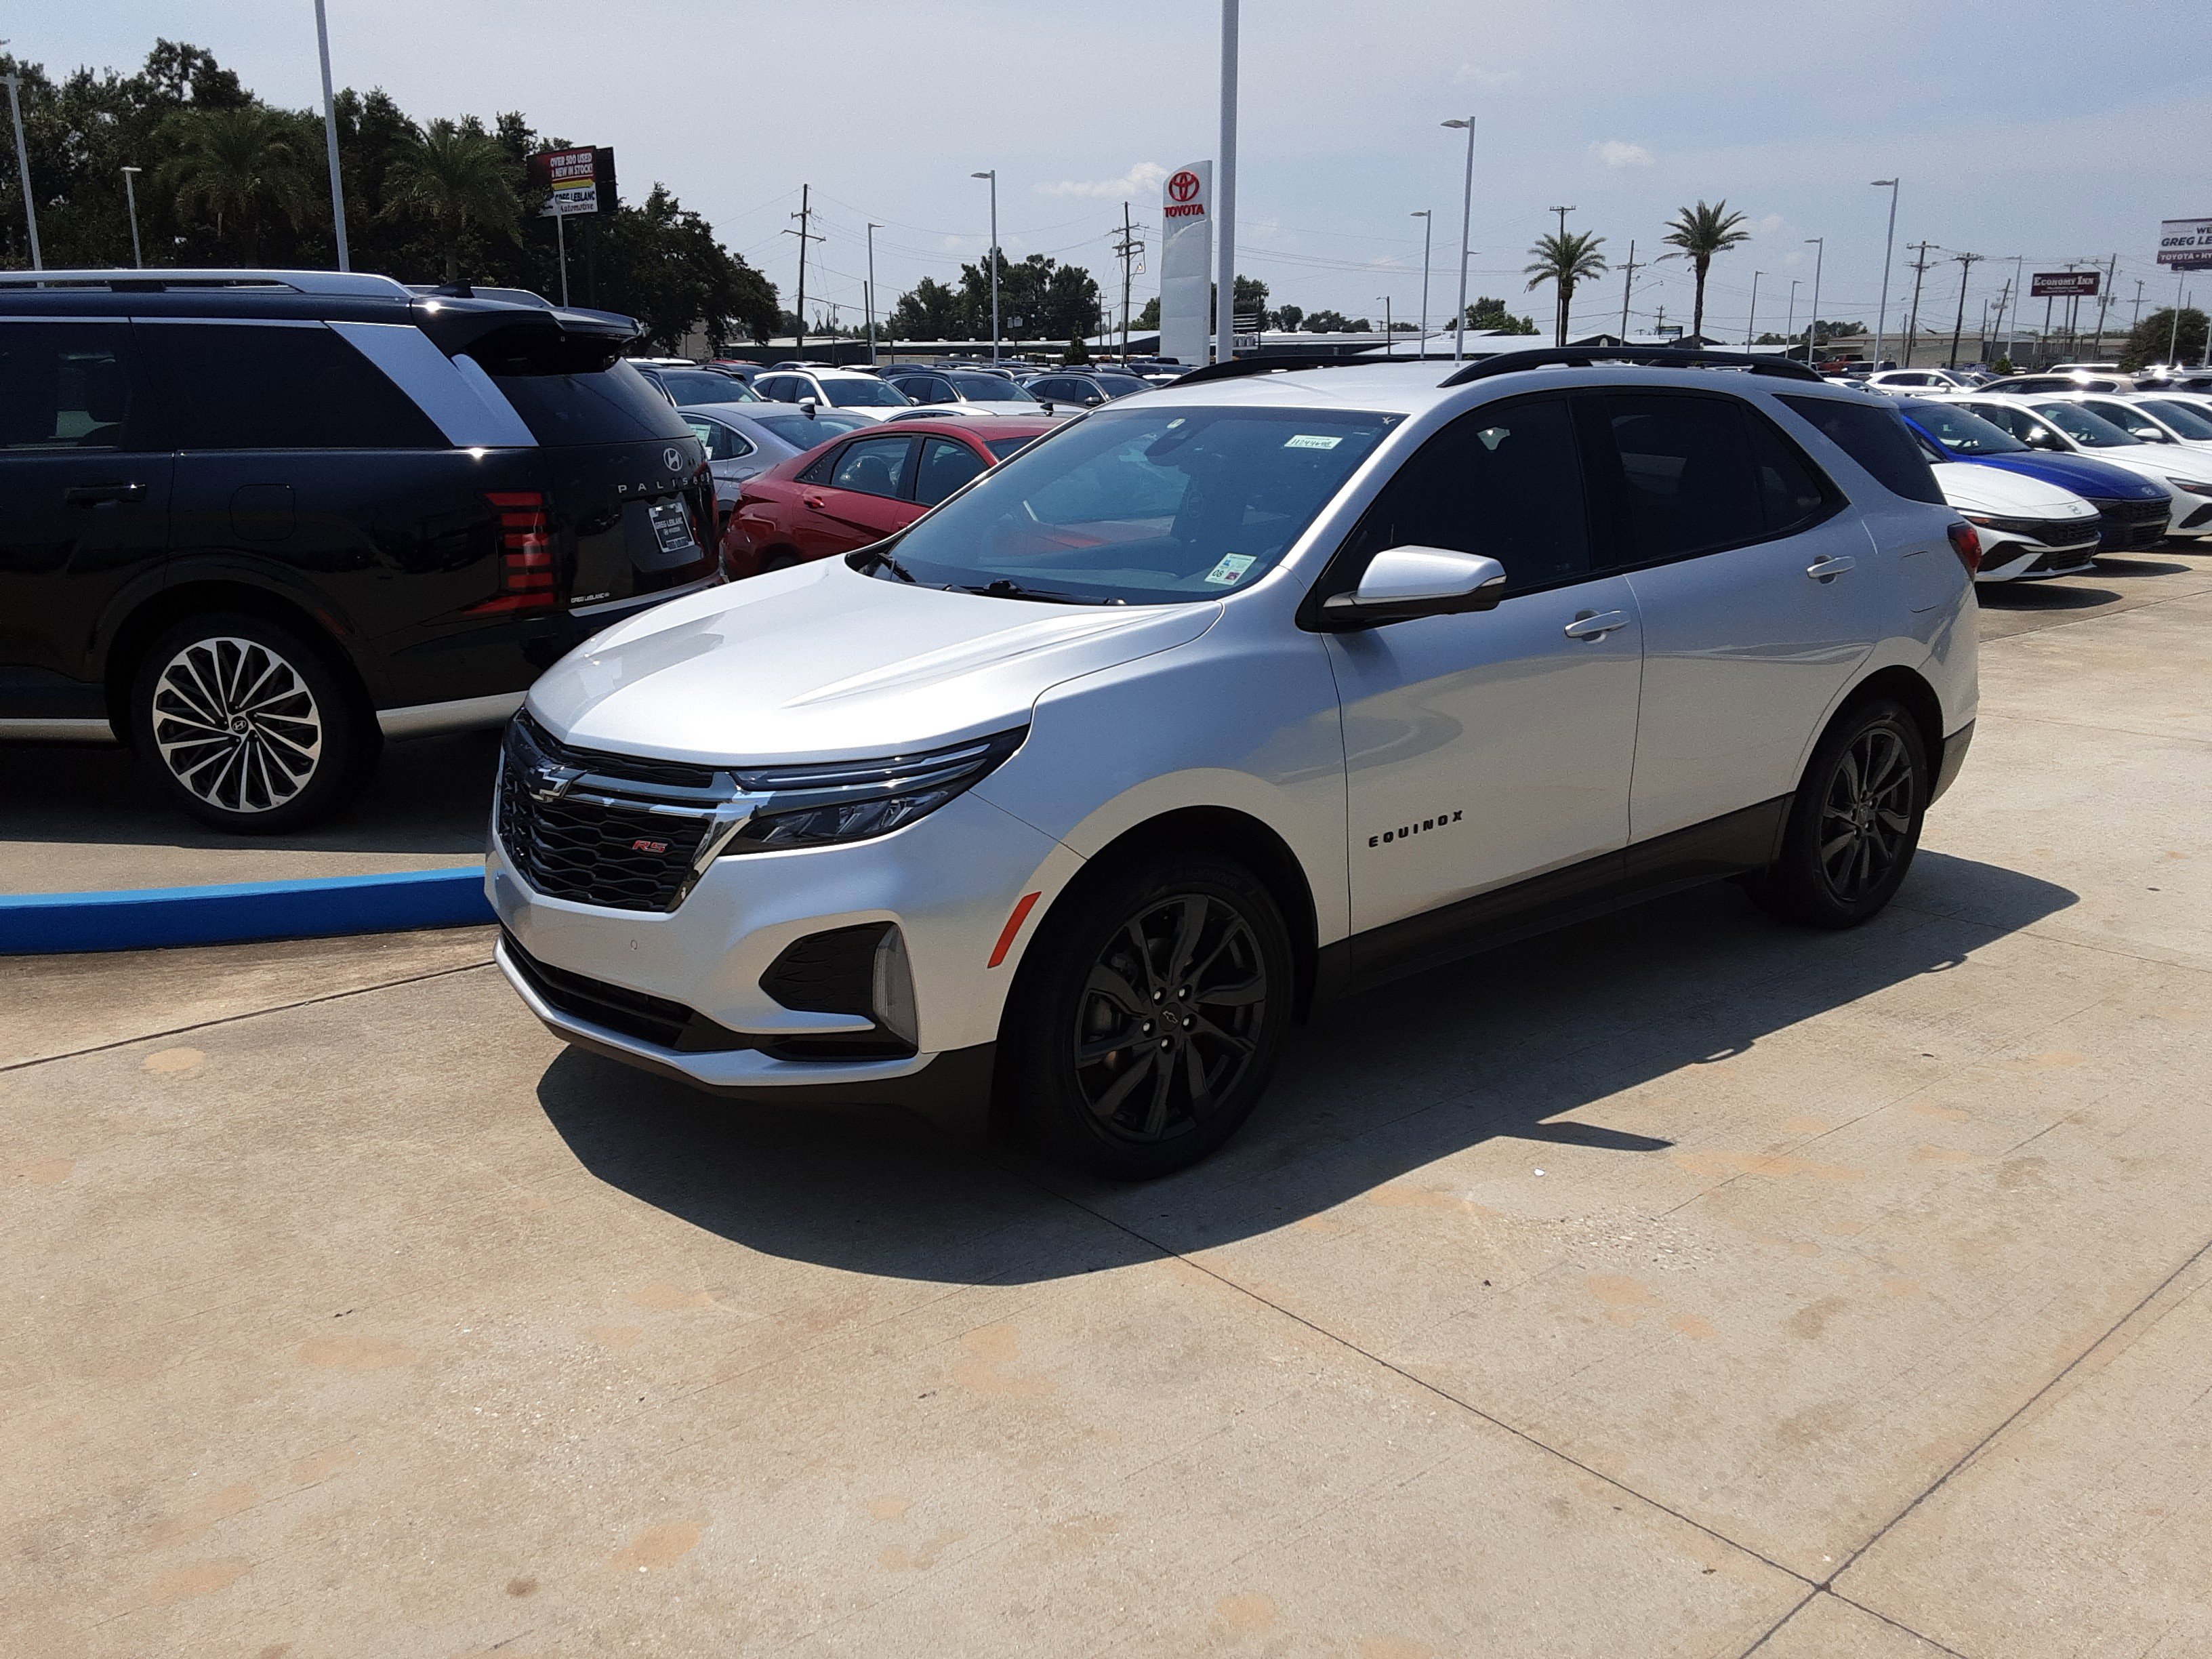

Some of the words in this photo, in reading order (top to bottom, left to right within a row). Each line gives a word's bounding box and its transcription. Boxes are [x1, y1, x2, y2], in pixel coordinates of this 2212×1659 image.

[550, 156, 565, 167] OVER
[566, 154, 576, 165] 500
[577, 152, 592, 163] USED
[555, 167, 567, 178] NEW
[568, 165, 574, 176] IN
[571, 190, 596, 202] LEBLANC
[1164, 204, 1204, 218] TOYOTA
[2161, 236, 2195, 247] GREG
[2160, 252, 2194, 261] TOYOTA
[1368, 810, 1462, 848] EQUINOX
[632, 840, 668, 853] RS
